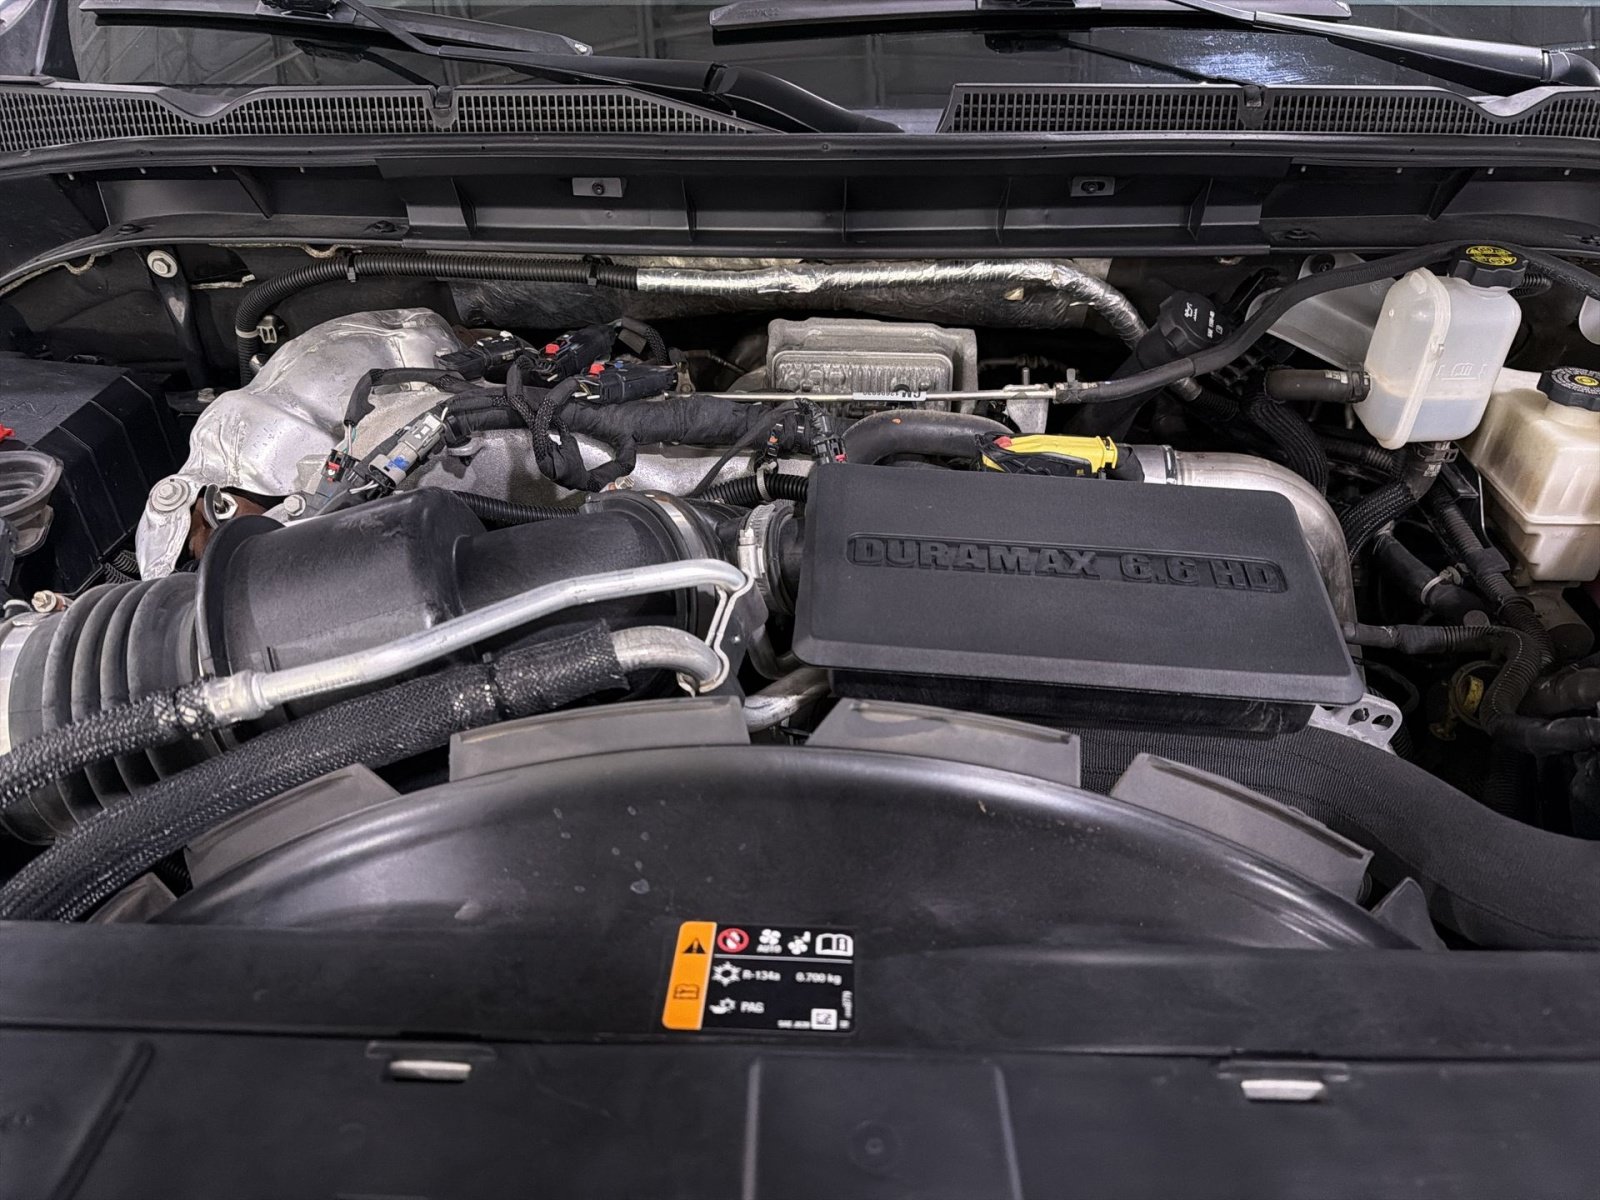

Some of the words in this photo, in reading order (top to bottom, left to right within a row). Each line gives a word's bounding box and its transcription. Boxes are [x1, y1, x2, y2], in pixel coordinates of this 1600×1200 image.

[853, 536, 1101, 579] DURAMAX
[1119, 553, 1199, 584] 6.6
[1210, 559, 1284, 591] HD
[741, 969, 781, 982] R-134a
[826, 973, 842, 986] kg
[740, 1001, 765, 1014] PAG
